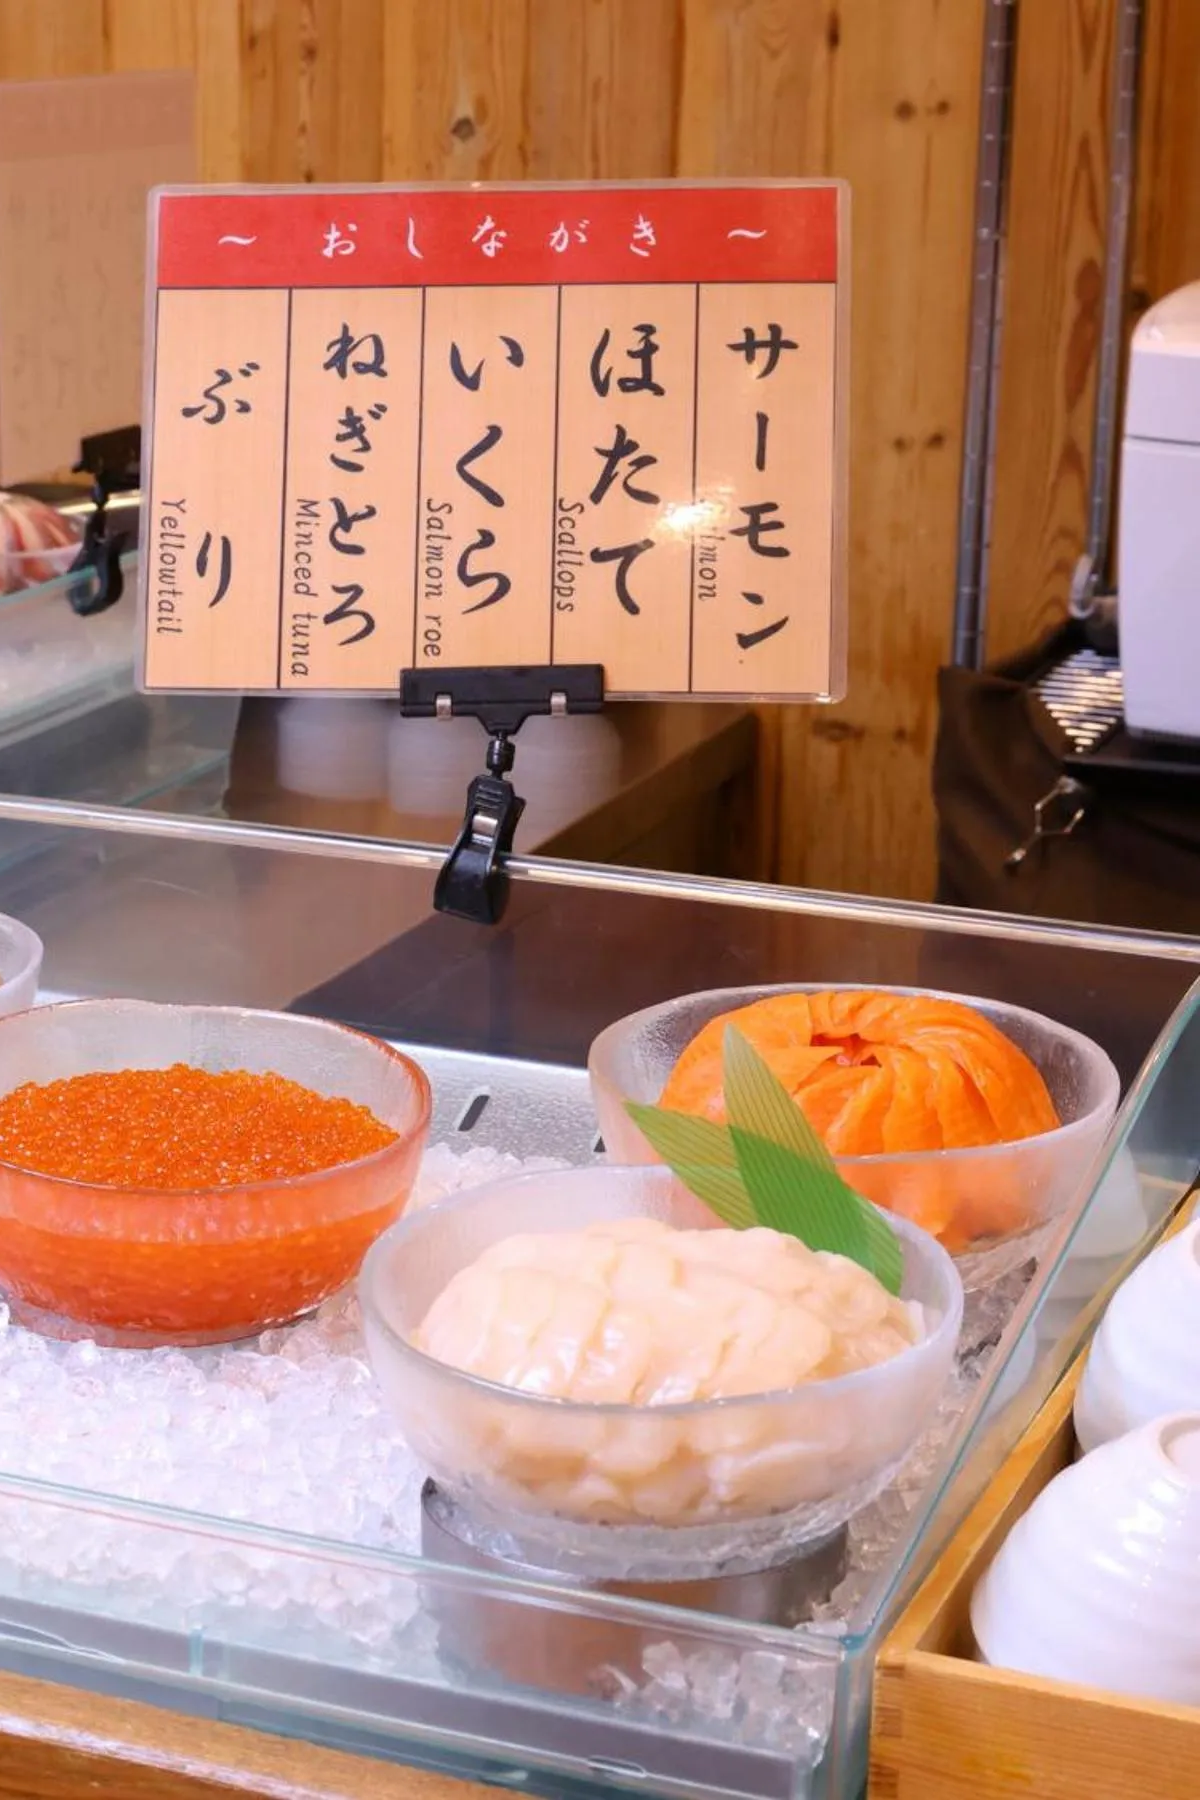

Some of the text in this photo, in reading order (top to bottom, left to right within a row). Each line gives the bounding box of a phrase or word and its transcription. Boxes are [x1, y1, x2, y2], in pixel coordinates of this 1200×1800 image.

[156, 498, 186, 635] Yellowtail
[181, 362, 261, 608] ぶり
[322, 323, 389, 647] ねぎとろ
[449, 335, 525, 615] いくら
[555, 497, 586, 613] Scallops
[590, 323, 666, 616] ほたて
[697, 498, 726, 602] lmon
[727, 323, 799, 650] サーモン
[290, 499, 321, 678] Minced tuna
[422, 497, 453, 658] Salmon roe
